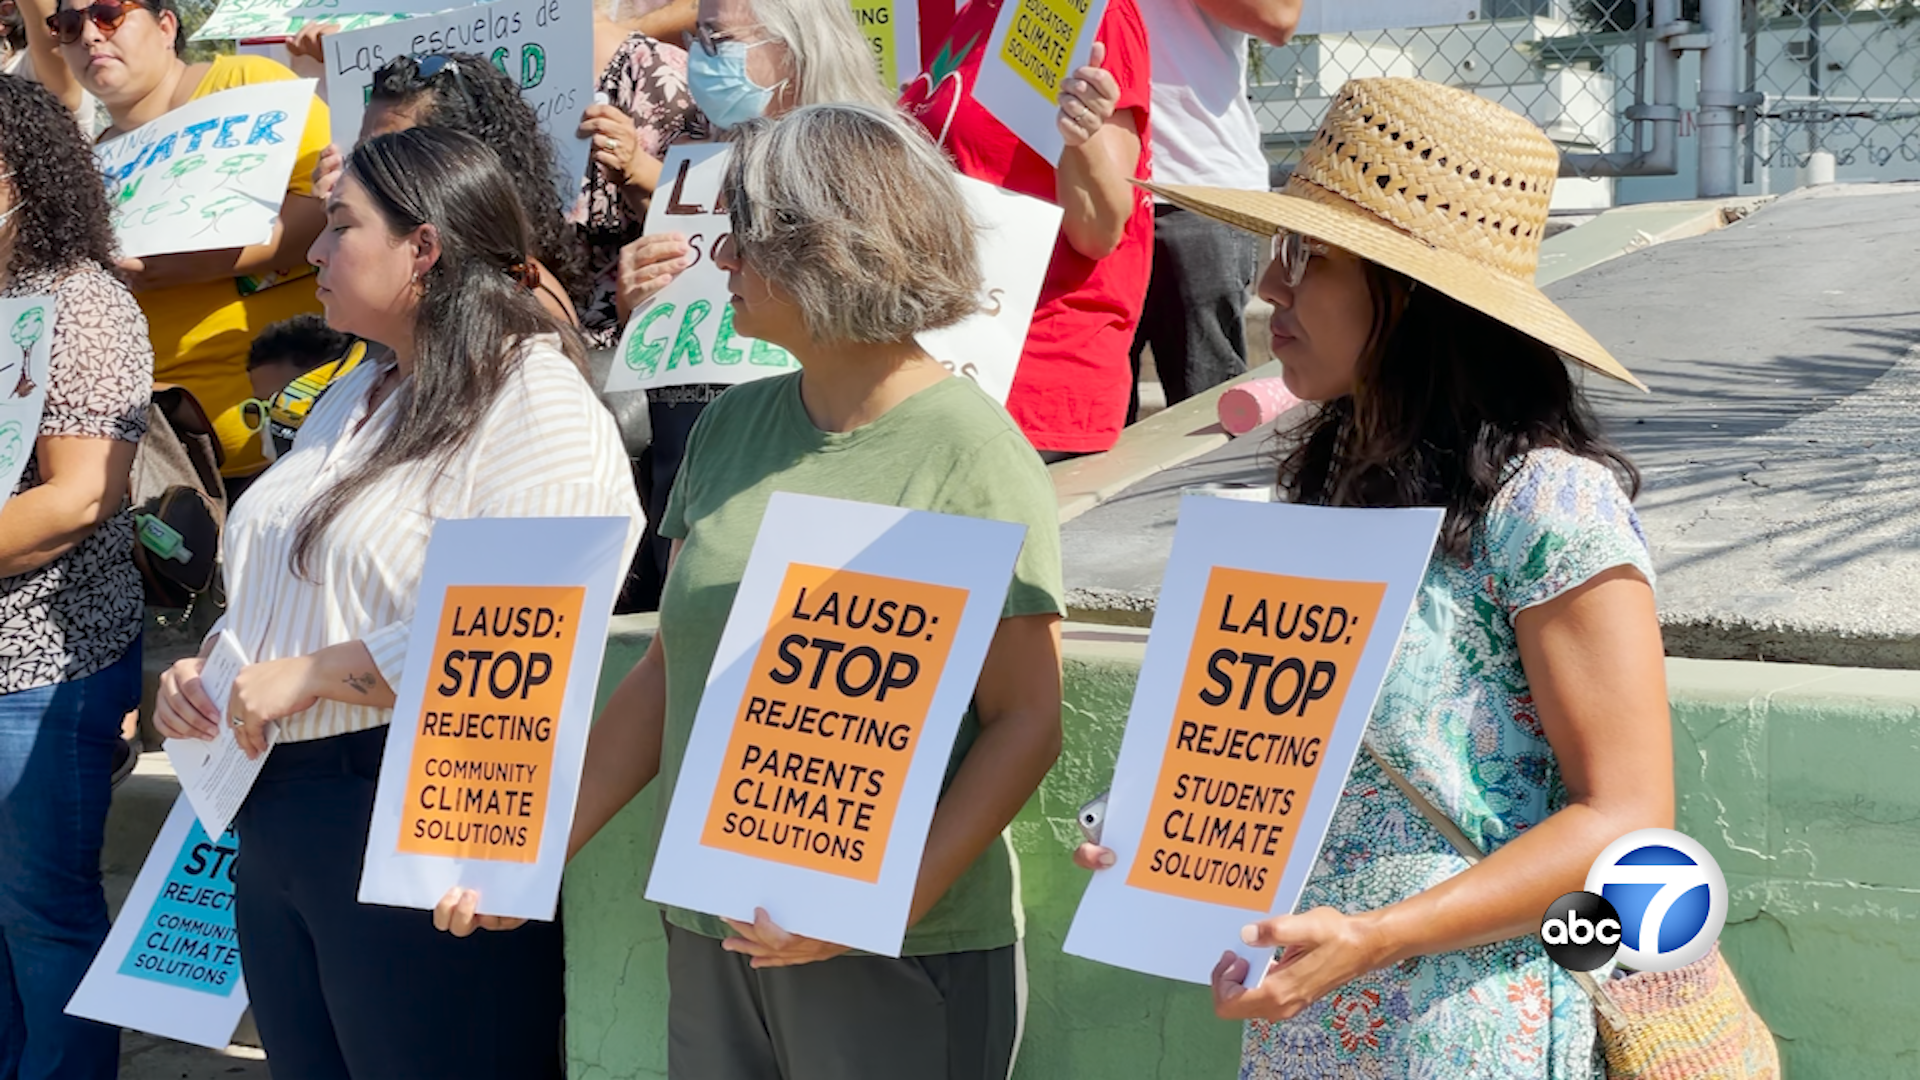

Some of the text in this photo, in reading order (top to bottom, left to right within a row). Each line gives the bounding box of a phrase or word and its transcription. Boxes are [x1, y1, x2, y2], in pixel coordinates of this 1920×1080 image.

[334, 40, 384, 75] Las
[411, 8, 521, 54] escuelas
[536, 0, 561, 28] de
[1018, 14, 1066, 67] CLIMATE
[1008, 38, 1057, 89] SOLUTIONS
[452, 606, 564, 638] LAUSD:
[792, 587, 939, 642] LAUSD:
[1219, 594, 1358, 645] LAUSD:
[437, 650, 552, 700] STOP
[768, 633, 920, 702] STOP
[1198, 648, 1337, 717] STOP
[422, 712, 551, 742] REJECTING
[745, 696, 911, 751] REJECTING
[1176, 720, 1320, 768] REJECTING
[425, 758, 538, 783] COMMUNITY
[741, 744, 885, 797] PARENTS
[1173, 774, 1295, 815] STUDENTS
[420, 784, 534, 817] CLIMATE
[733, 778, 875, 832] CLIMATE
[414, 819, 527, 847] SOLUTIONS
[723, 812, 865, 862] SOLUTIONS
[1164, 810, 1283, 856] CLIMATE
[1150, 849, 1268, 892] SOLUTIONS
[163, 882, 236, 912] REJECT
[146, 932, 239, 965] CLIMATE
[157, 914, 237, 941] COMMUNIT
[134, 953, 228, 985] SOLUTIONS
